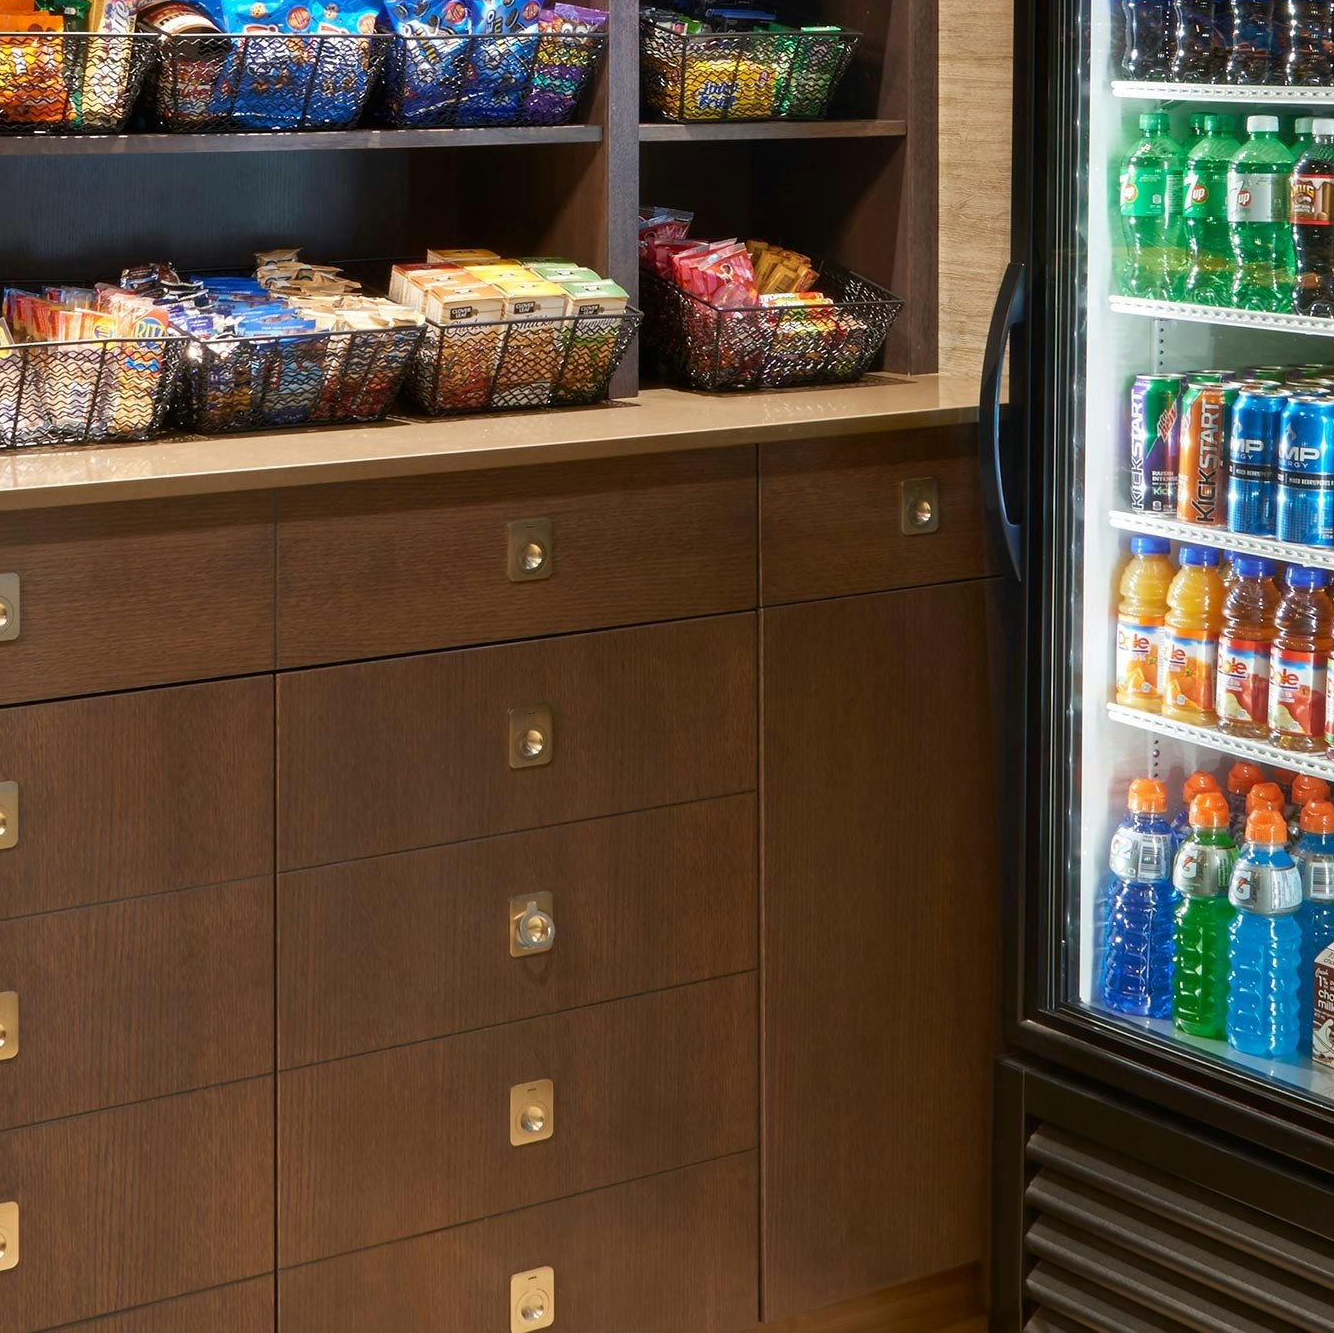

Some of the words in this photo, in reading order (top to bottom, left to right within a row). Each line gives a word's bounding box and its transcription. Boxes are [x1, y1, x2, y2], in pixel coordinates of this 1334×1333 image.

[134, 318, 166, 339] RITZ
[1131, 389, 1145, 510] KICKSTART
[1192, 401, 1220, 523] KICKSTART
